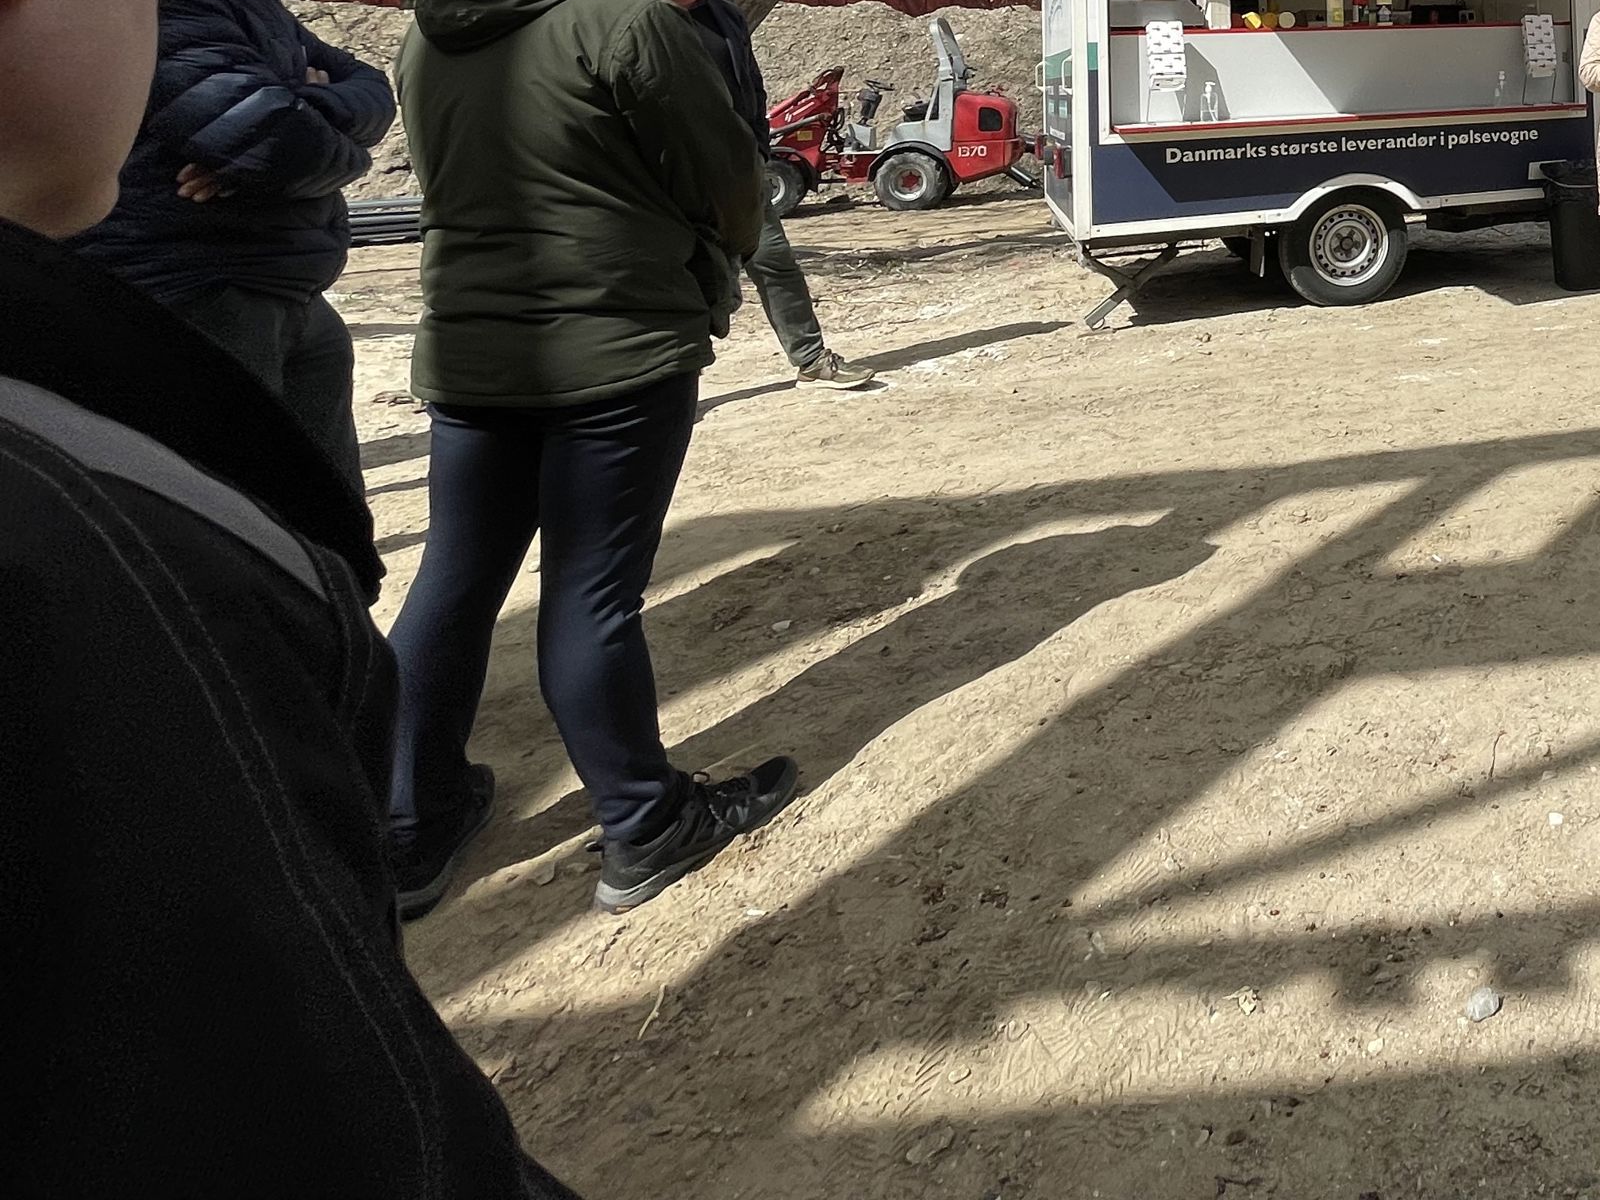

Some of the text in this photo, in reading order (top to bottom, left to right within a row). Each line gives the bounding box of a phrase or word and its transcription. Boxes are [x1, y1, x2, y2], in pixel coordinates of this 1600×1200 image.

[957, 145, 988, 158] 1370
[1165, 129, 1539, 164] Danmarks største leverandør i pølsevogne
